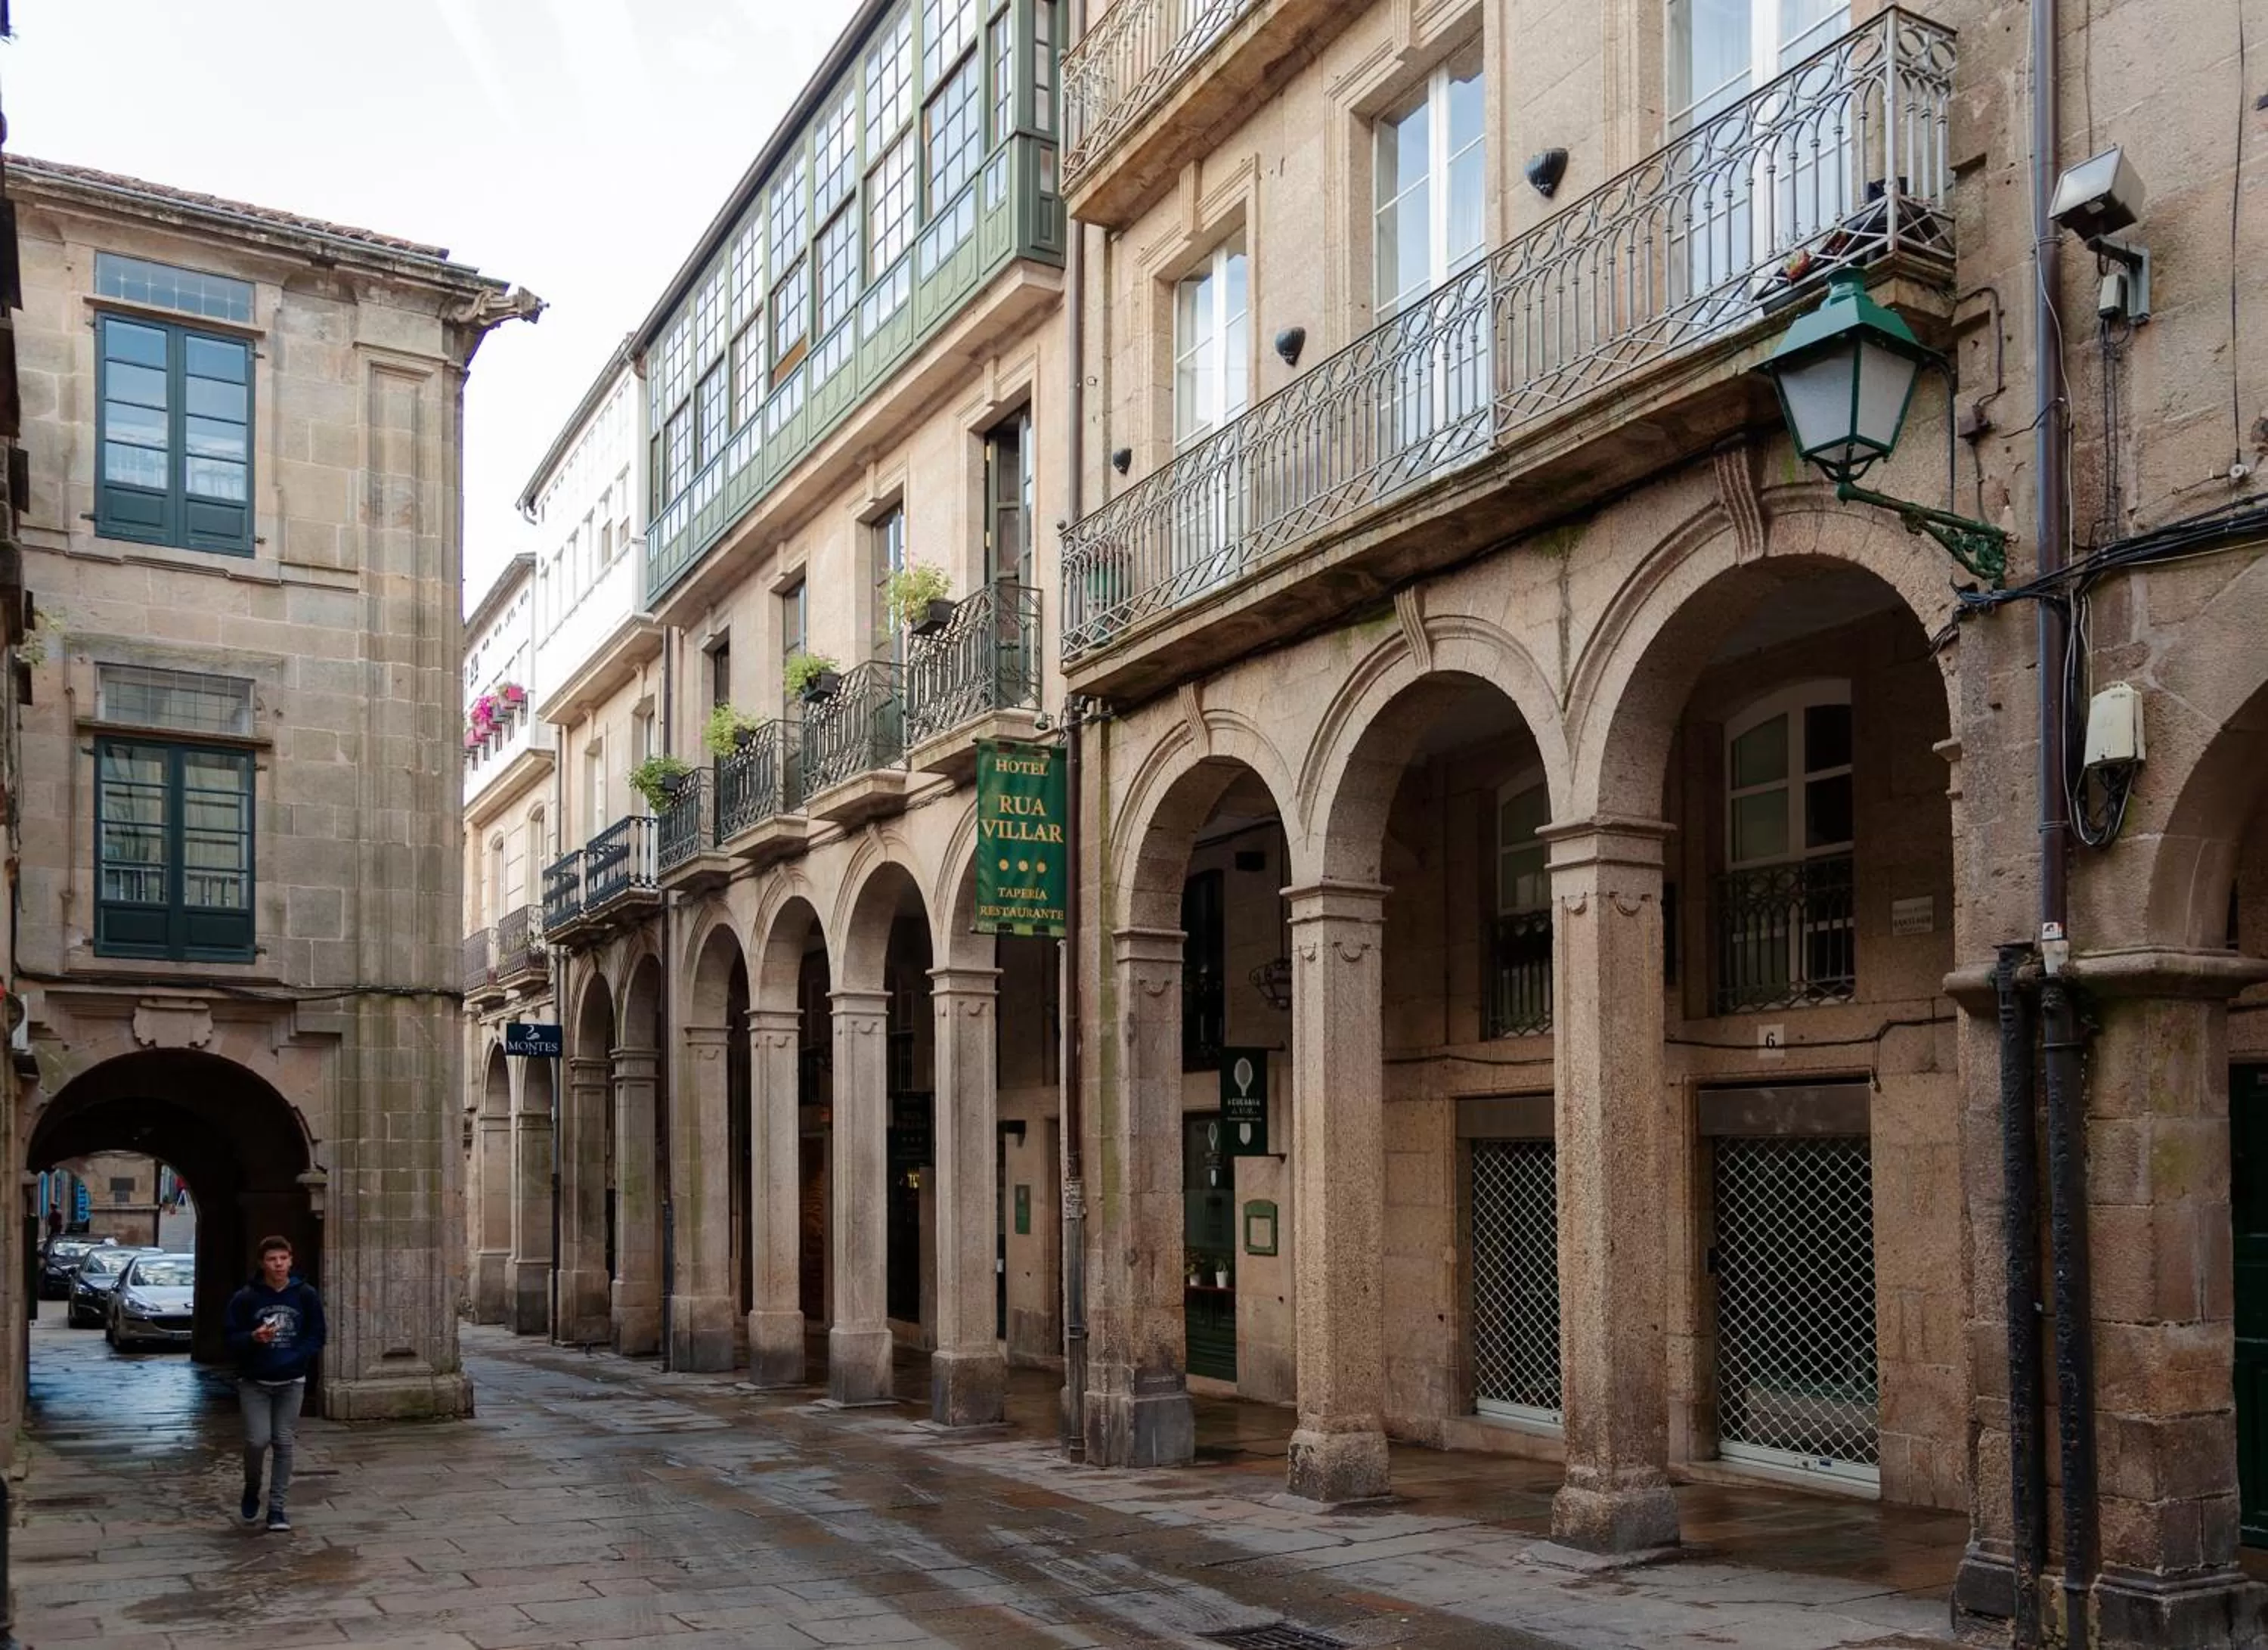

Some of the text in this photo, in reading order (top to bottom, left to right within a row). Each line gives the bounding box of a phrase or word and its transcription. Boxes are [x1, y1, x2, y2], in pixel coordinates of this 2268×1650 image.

[995, 758, 1049, 776] HOTEL
[998, 795, 1047, 816] RUA
[981, 819, 1064, 842] VILLAR
[979, 905, 1064, 920] RESTAURANTE
[507, 1041, 559, 1052] MONTES
[1765, 1031, 1776, 1049] 6
